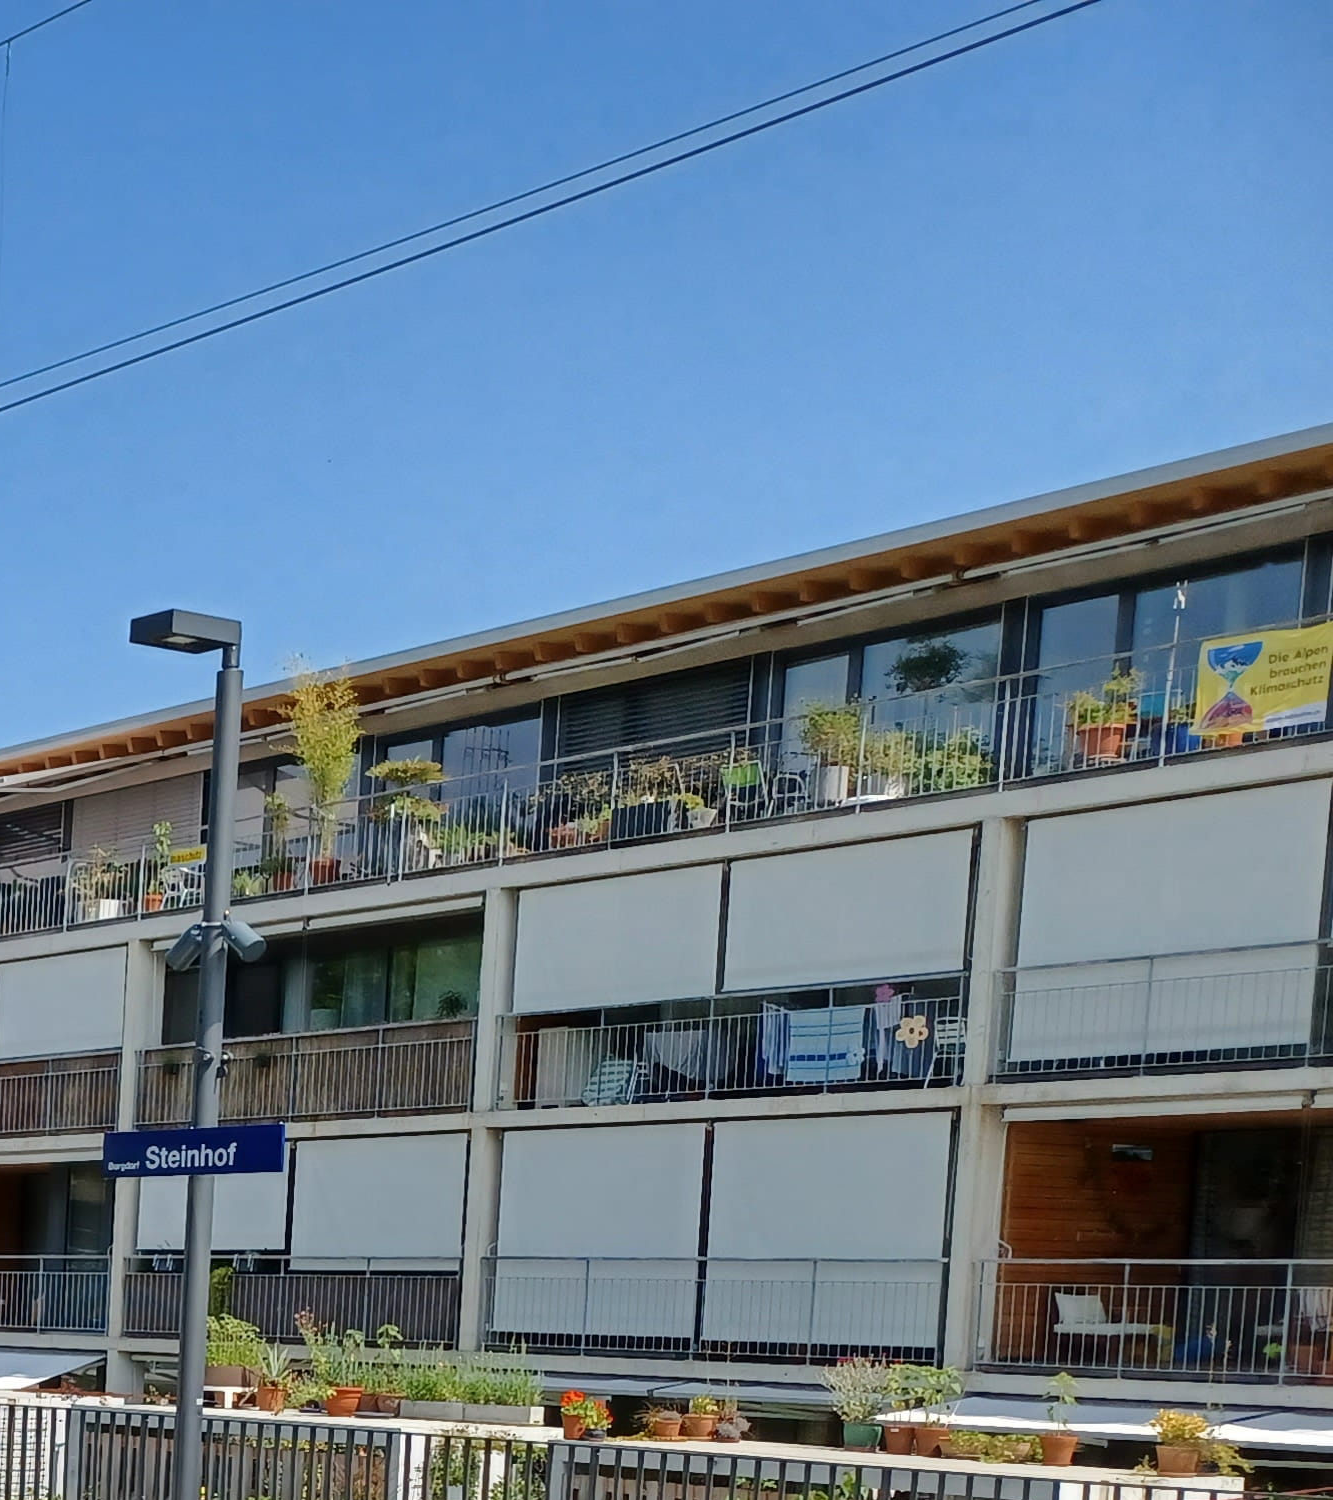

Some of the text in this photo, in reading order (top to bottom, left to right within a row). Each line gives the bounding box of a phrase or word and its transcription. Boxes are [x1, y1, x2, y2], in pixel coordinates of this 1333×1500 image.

[1268, 645, 1328, 665] Die Alpen
[1269, 660, 1327, 679] brauchen
[1250, 675, 1324, 696] Klimaschutz
[145, 1142, 238, 1170] Steinhof
